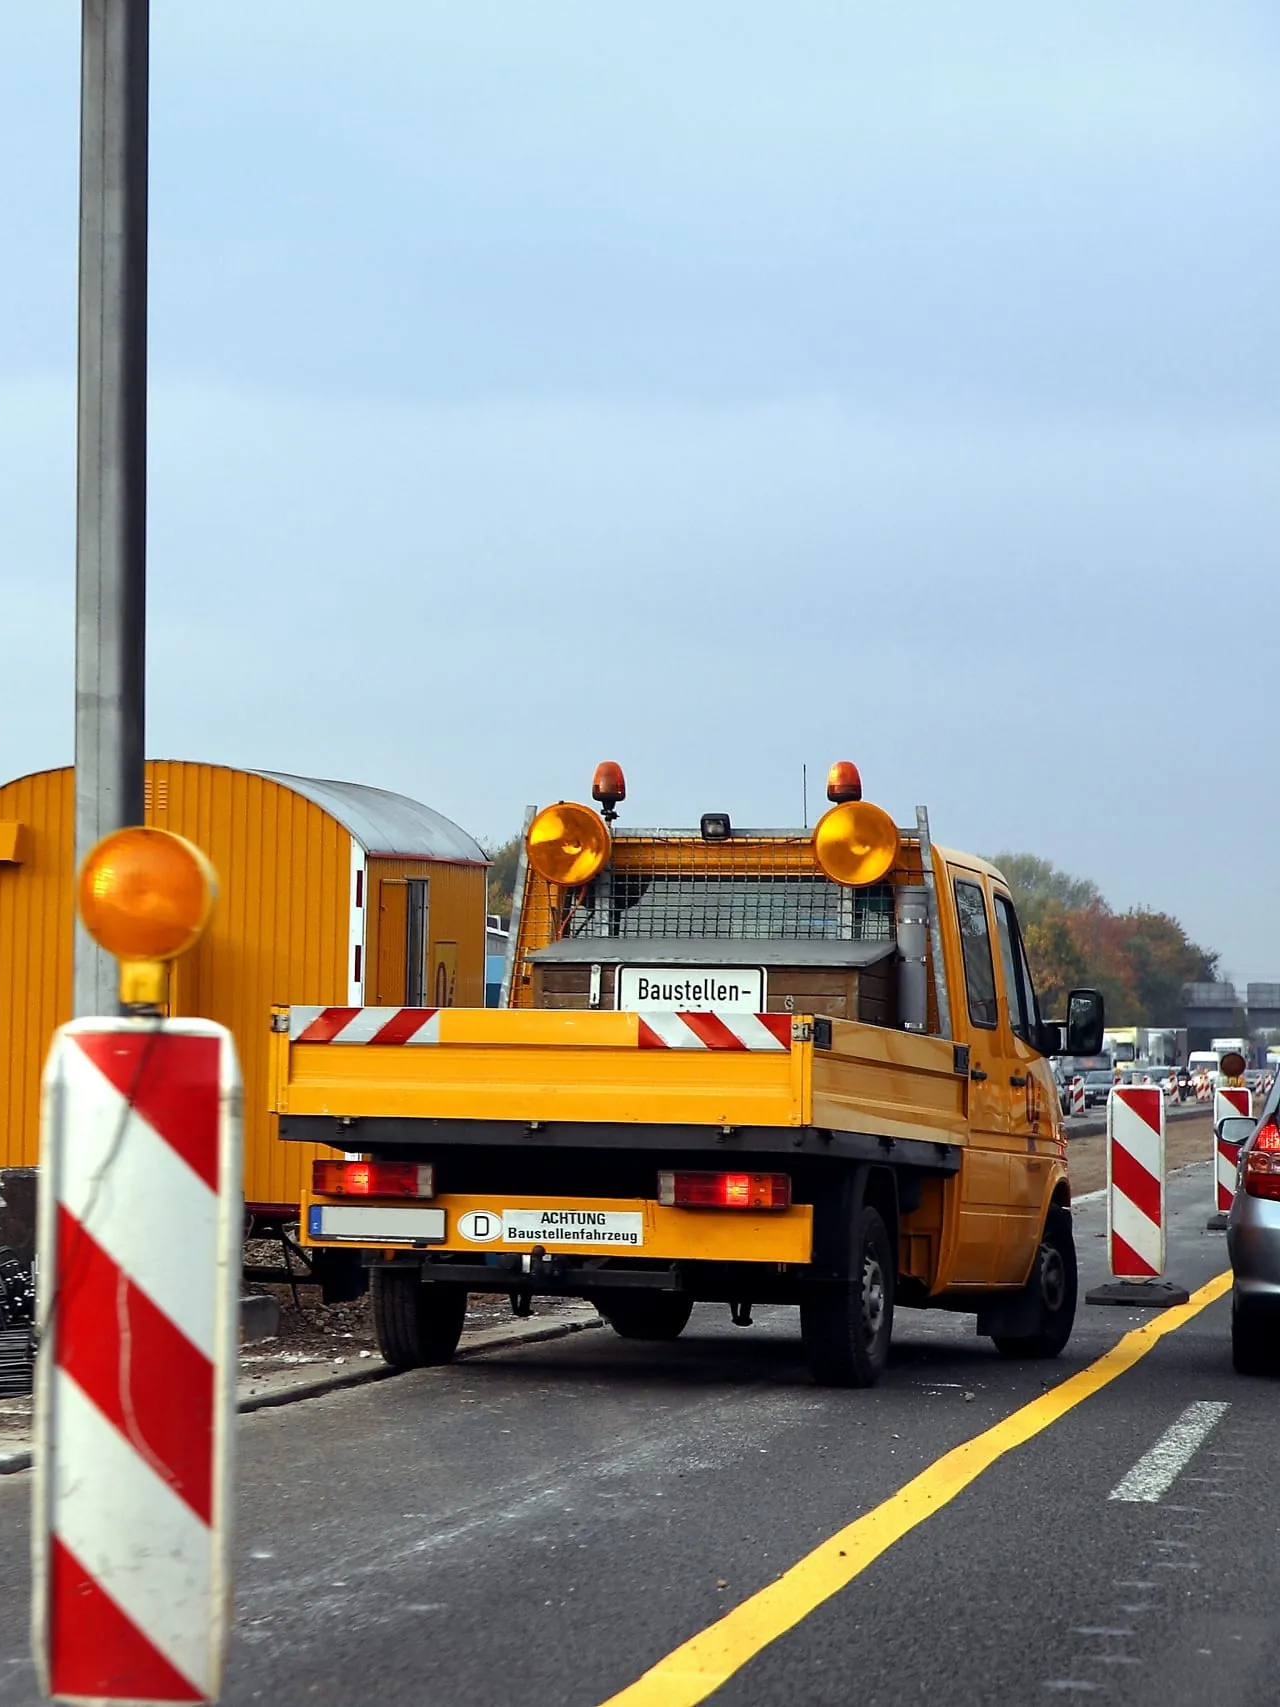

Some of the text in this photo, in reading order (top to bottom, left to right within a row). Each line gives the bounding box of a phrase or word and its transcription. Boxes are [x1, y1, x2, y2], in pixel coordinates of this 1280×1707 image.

[638, 978, 751, 1001] Baustellen-
[474, 1216, 490, 1237] D
[540, 1212, 606, 1225] ACHTUNG
[508, 1227, 638, 1244] Baustellenfahrzeug
